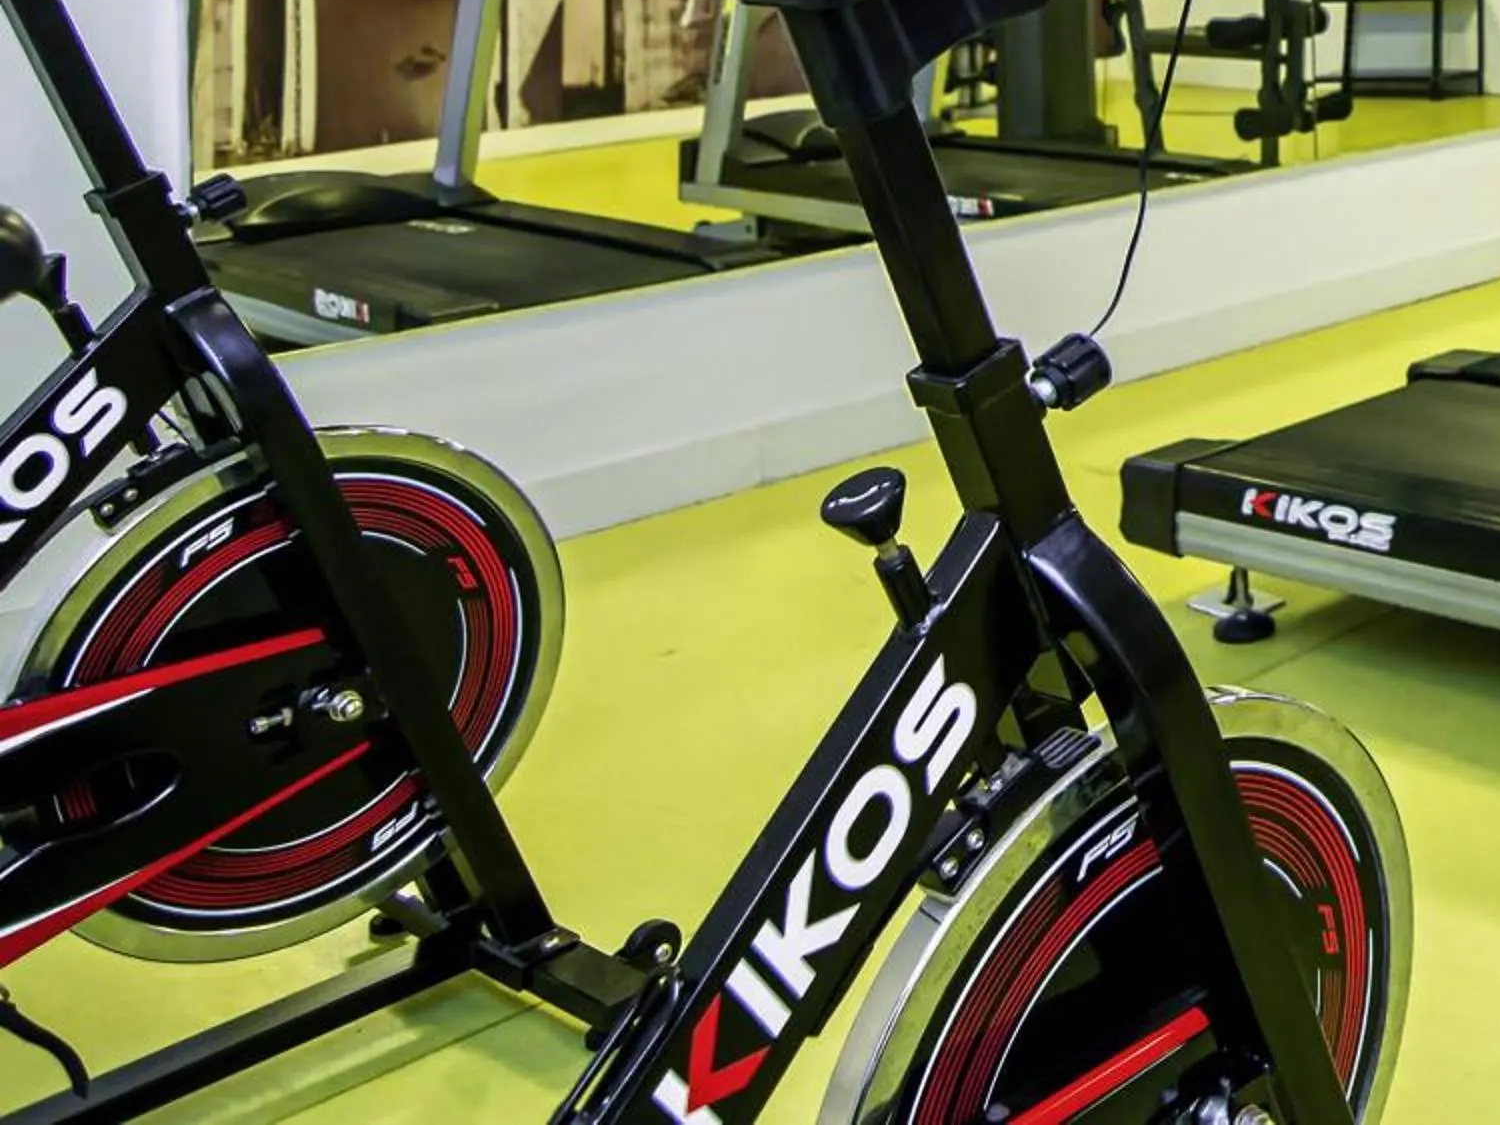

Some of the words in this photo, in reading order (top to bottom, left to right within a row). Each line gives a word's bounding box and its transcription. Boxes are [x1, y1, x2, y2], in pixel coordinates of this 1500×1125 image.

[0, 366, 128, 542] OS
[1241, 487, 1398, 543] KIKOS
[652, 653, 977, 1125] KIKOS
